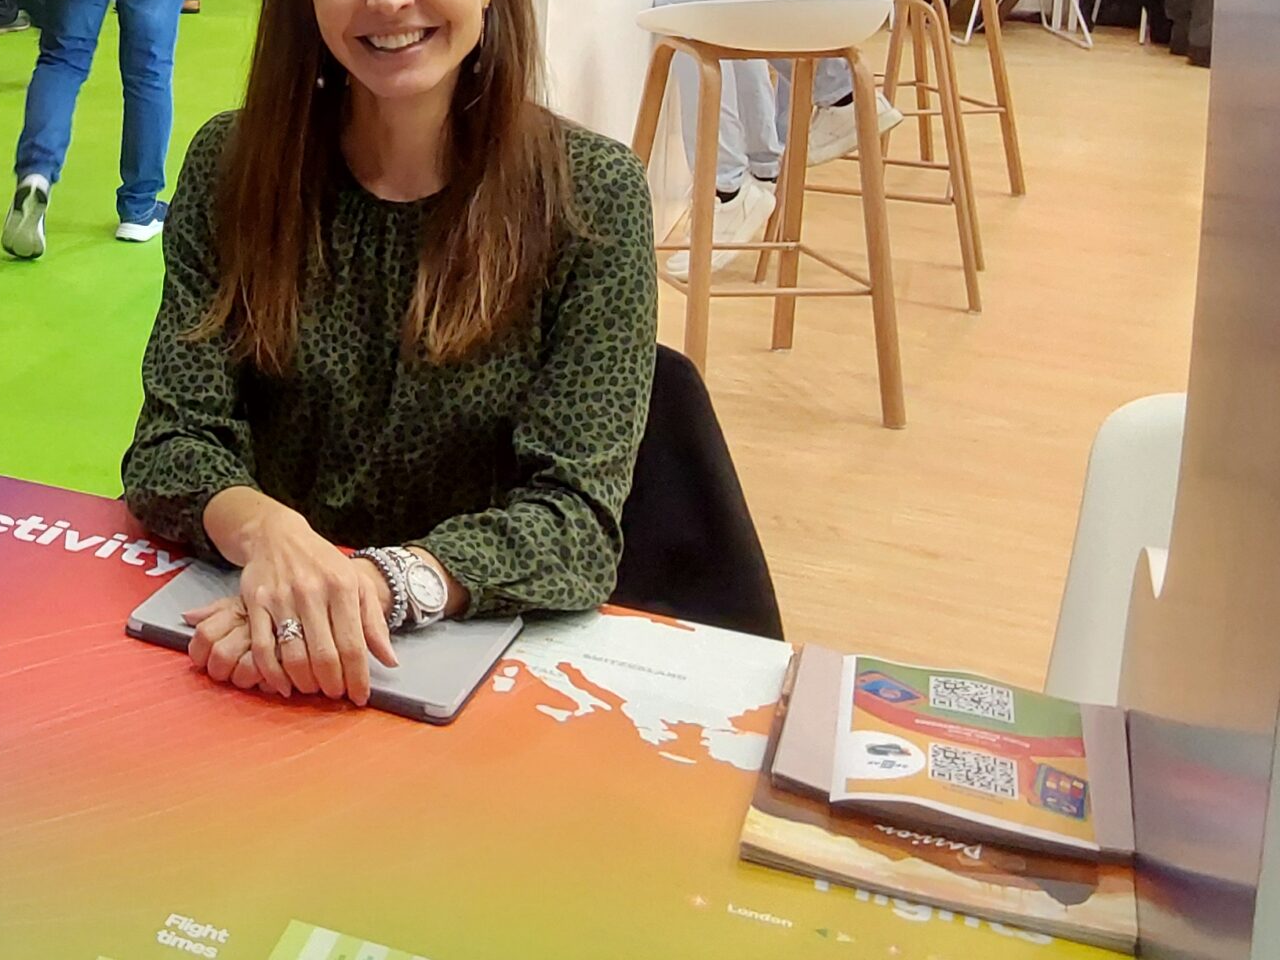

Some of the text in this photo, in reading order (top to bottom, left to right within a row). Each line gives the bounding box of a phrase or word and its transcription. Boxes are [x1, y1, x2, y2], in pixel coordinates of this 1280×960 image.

[165, 913, 230, 944] Flight
[728, 902, 794, 928] London
[157, 929, 218, 959] times
